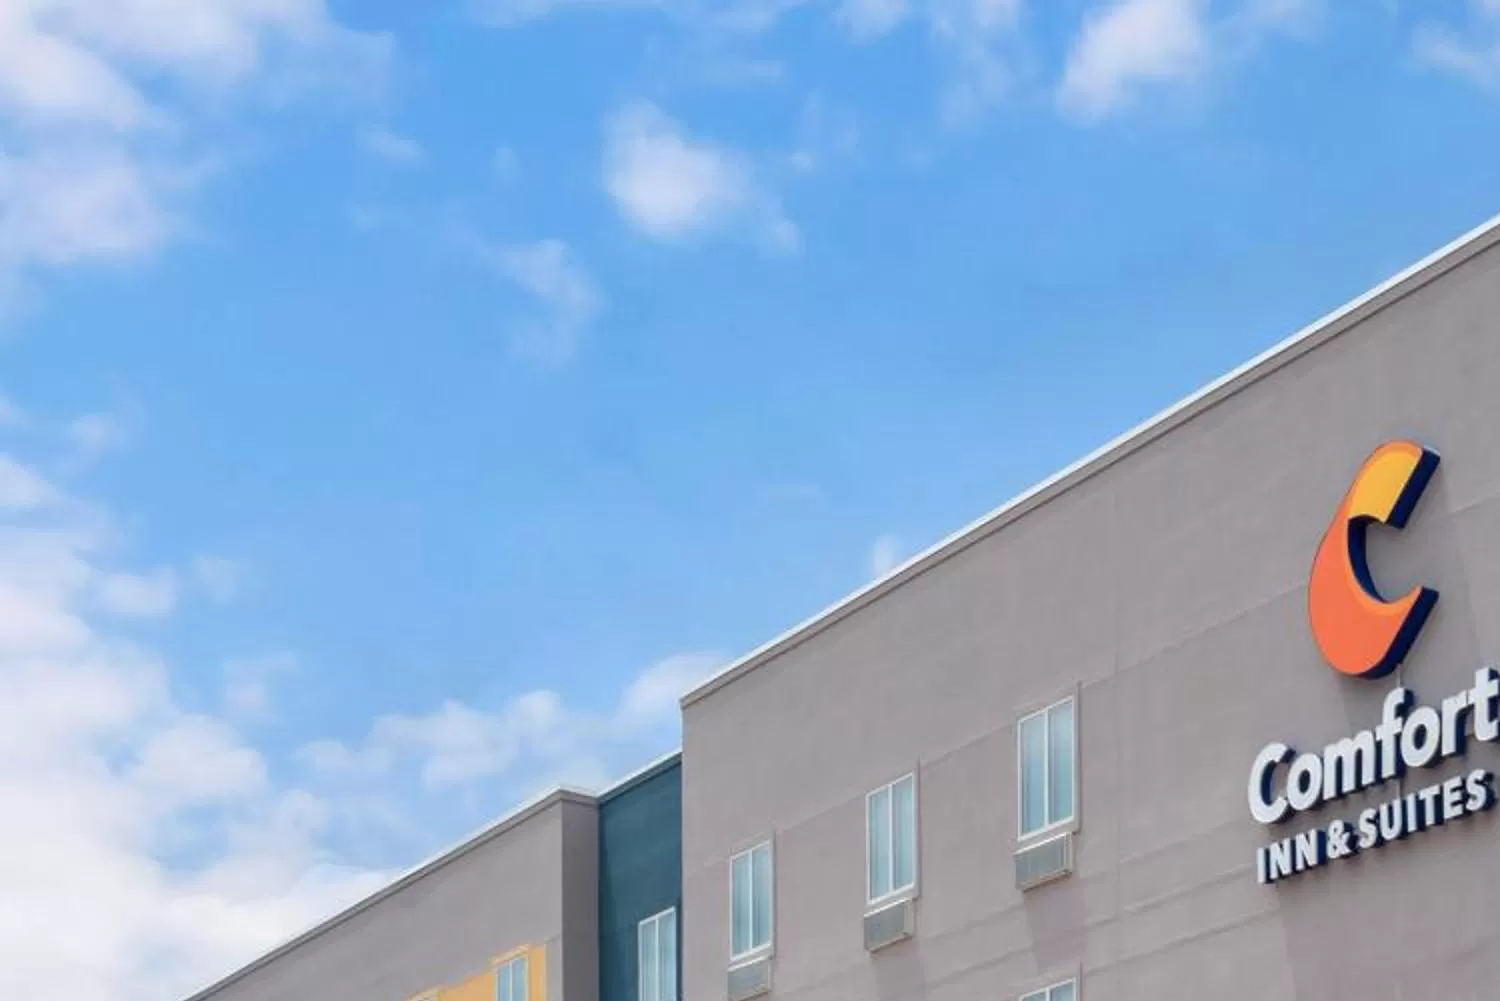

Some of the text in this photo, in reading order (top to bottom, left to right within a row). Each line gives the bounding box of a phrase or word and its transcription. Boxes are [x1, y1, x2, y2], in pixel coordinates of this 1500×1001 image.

[1257, 769, 1493, 884] INN & SUITES
